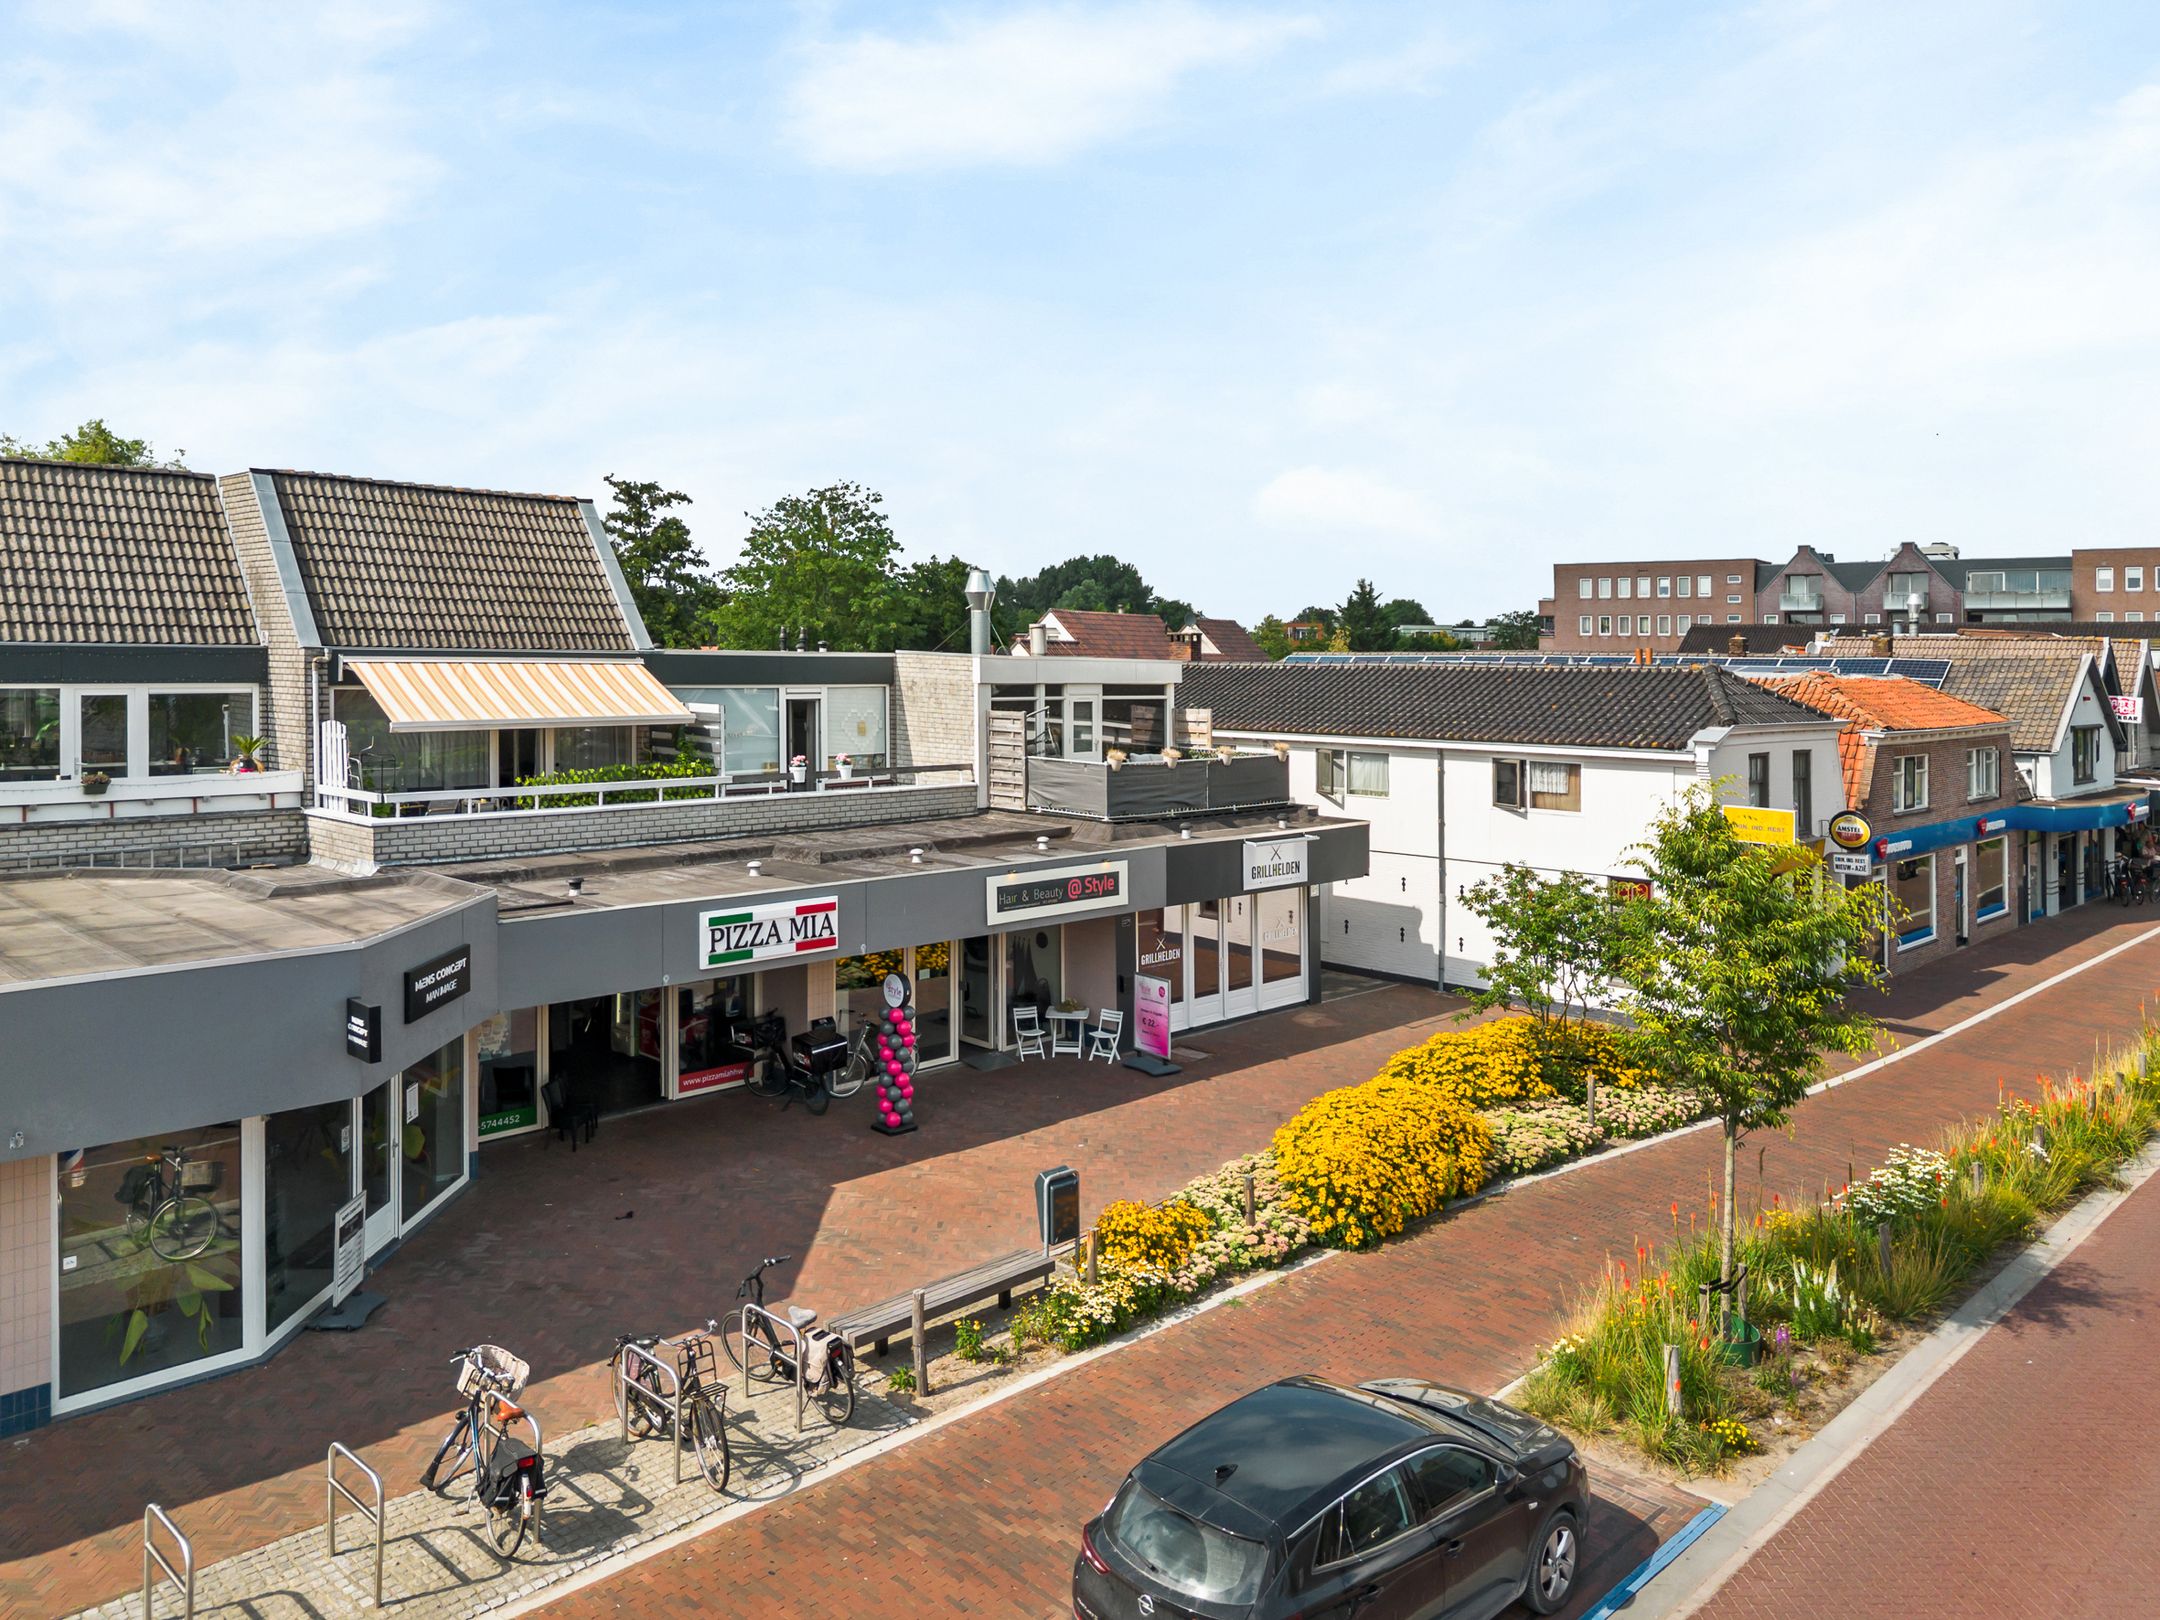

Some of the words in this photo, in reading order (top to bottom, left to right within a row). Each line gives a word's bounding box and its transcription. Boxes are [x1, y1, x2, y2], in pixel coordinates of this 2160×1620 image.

[1837, 825, 1860, 833] AMSTEL
[1251, 861, 1300, 879] GRILLHELDEN
[999, 892, 1017, 905] Hair
[1021, 889, 1029, 902] &
[1034, 888, 1064, 900] Beauty
[1068, 878, 1082, 899] @
[1084, 875, 1115, 895] Style
[709, 920, 783, 953] PIZZA
[789, 913, 835, 941] MIA
[1141, 949, 1180, 965] GRILLHELDEN
[415, 973, 435, 992] MENS
[436, 957, 467, 980] CONCEPT
[683, 1069, 745, 1086] www.pizzamiahhw
